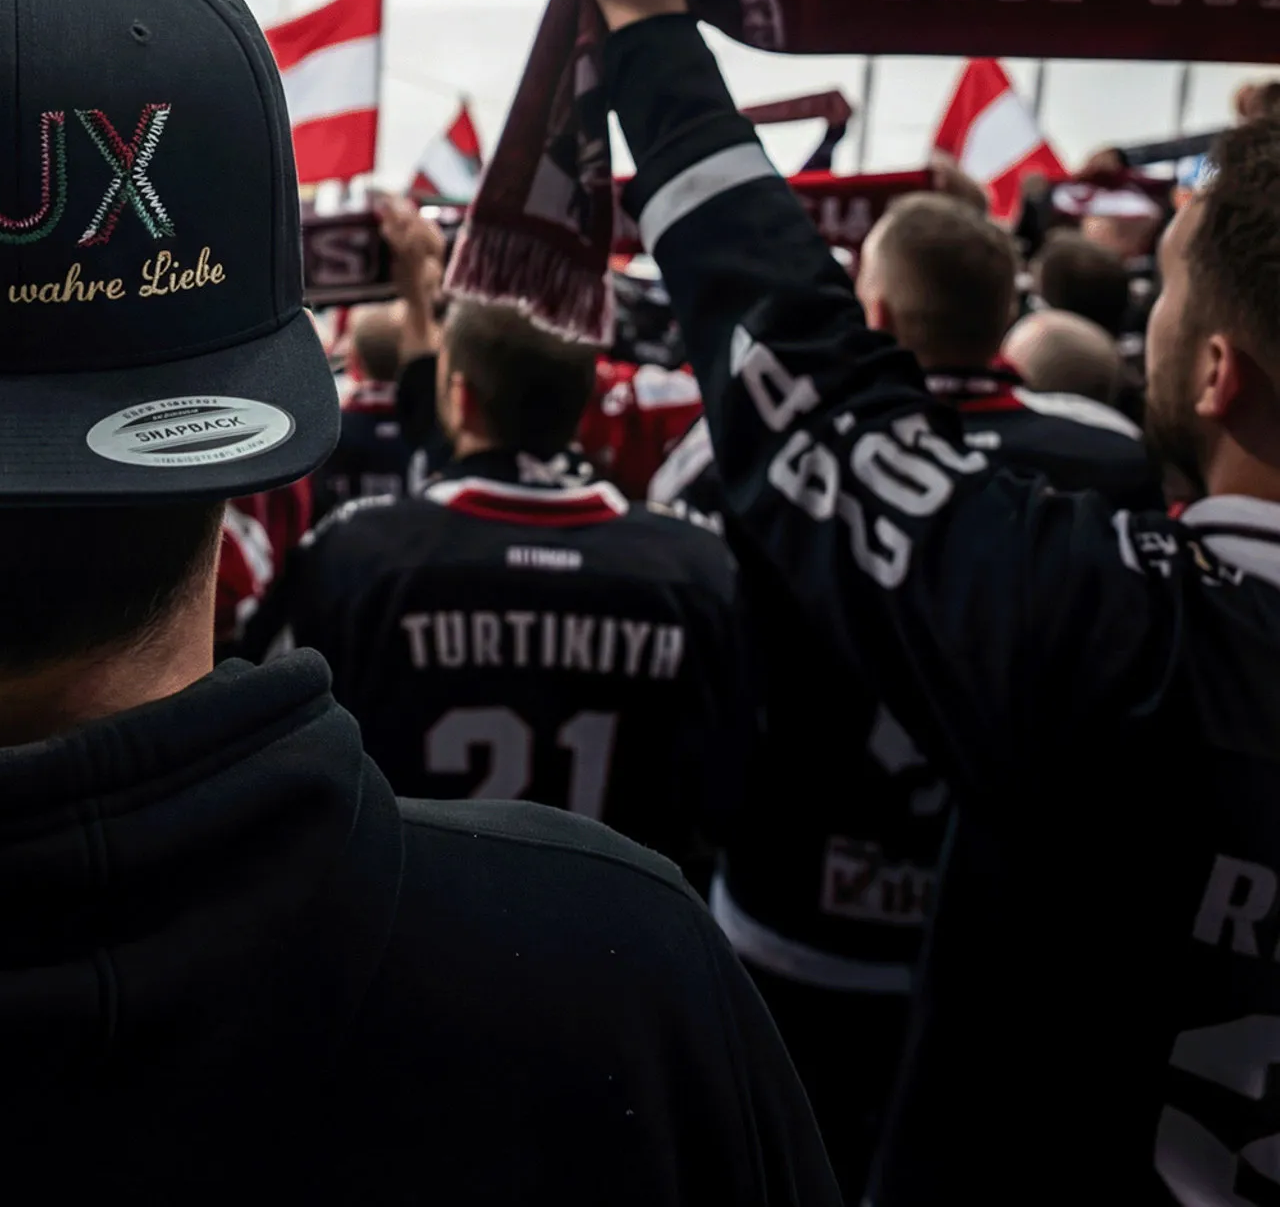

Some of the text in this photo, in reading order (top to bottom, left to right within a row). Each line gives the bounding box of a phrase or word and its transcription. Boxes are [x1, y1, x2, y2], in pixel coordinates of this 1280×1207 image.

[9, 263, 126, 304] wahre
[138, 246, 226, 298] Liebe
[423, 705, 620, 821] 21
[1191, 851, 1280, 963] R
